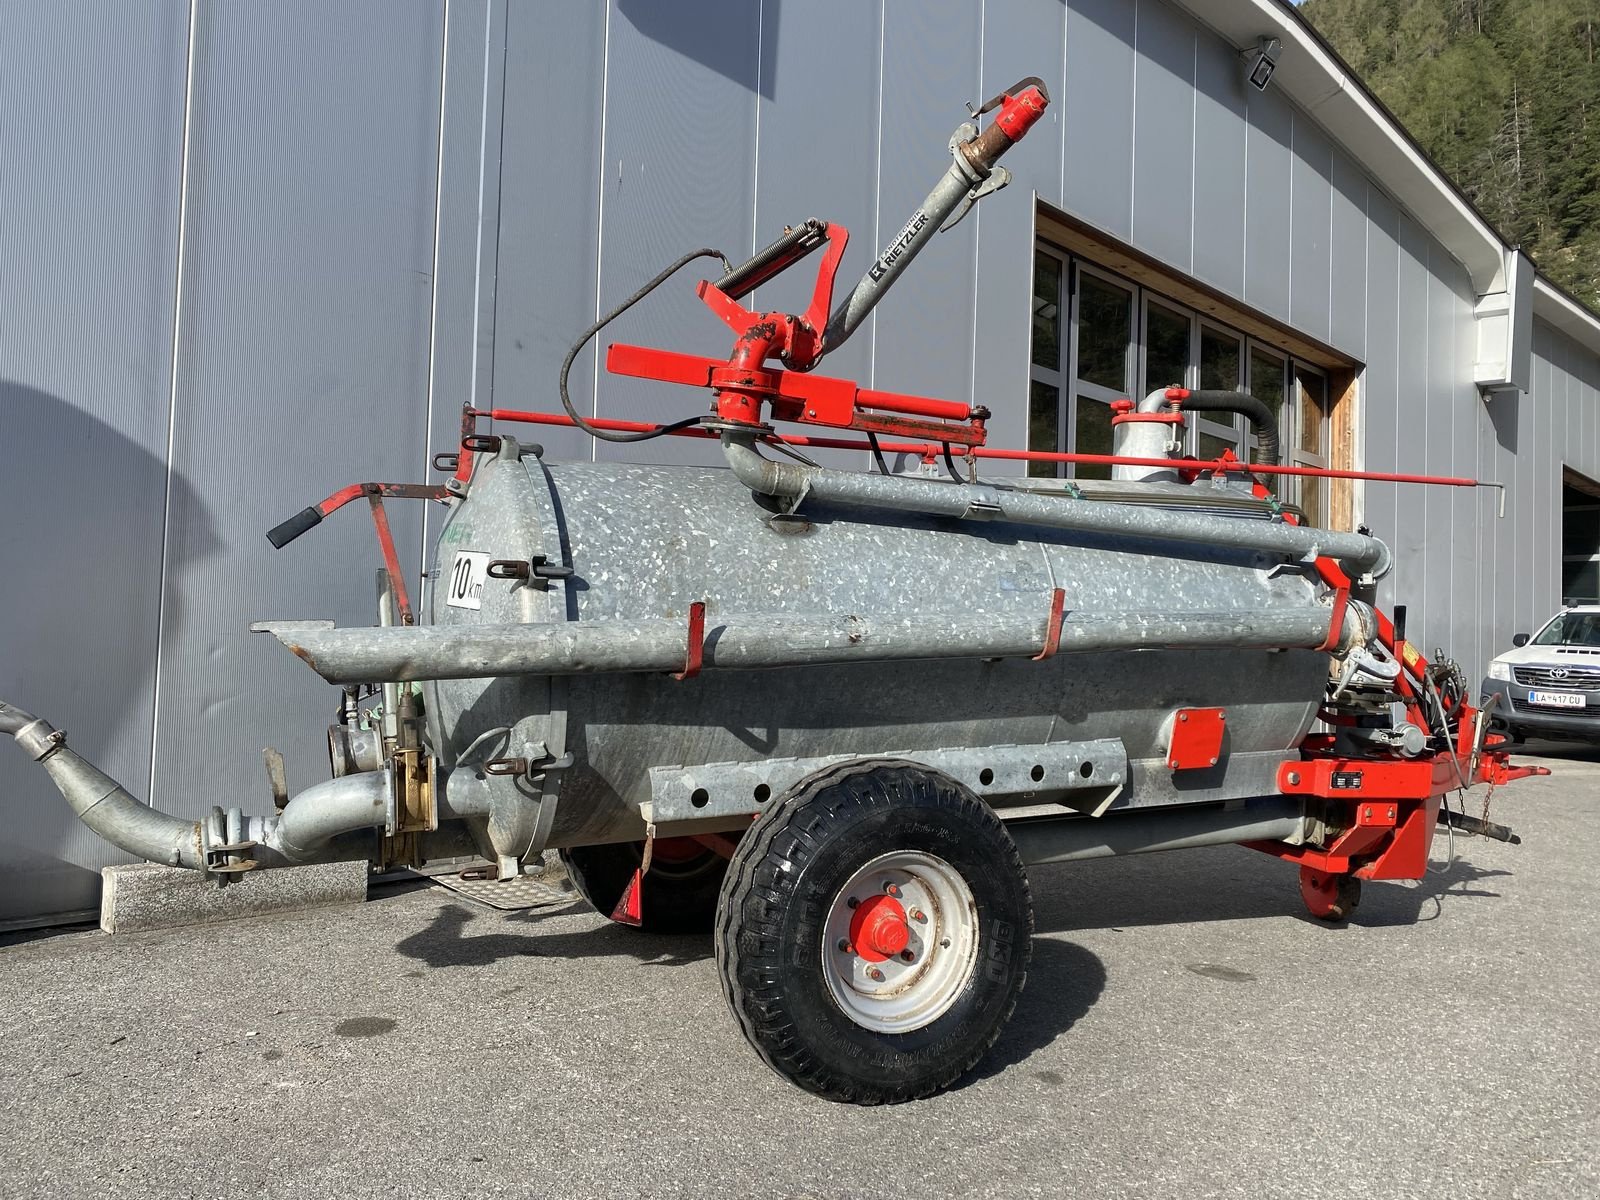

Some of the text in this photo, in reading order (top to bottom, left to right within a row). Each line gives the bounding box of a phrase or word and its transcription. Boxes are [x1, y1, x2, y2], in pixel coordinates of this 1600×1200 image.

[880, 211, 922, 261] LANDTECHNIK
[884, 214, 929, 267] RIETZLER
[451, 557, 483, 599] 10 km
[1536, 694, 1580, 705] LA 417 CU
[988, 919, 1014, 985] BKT
